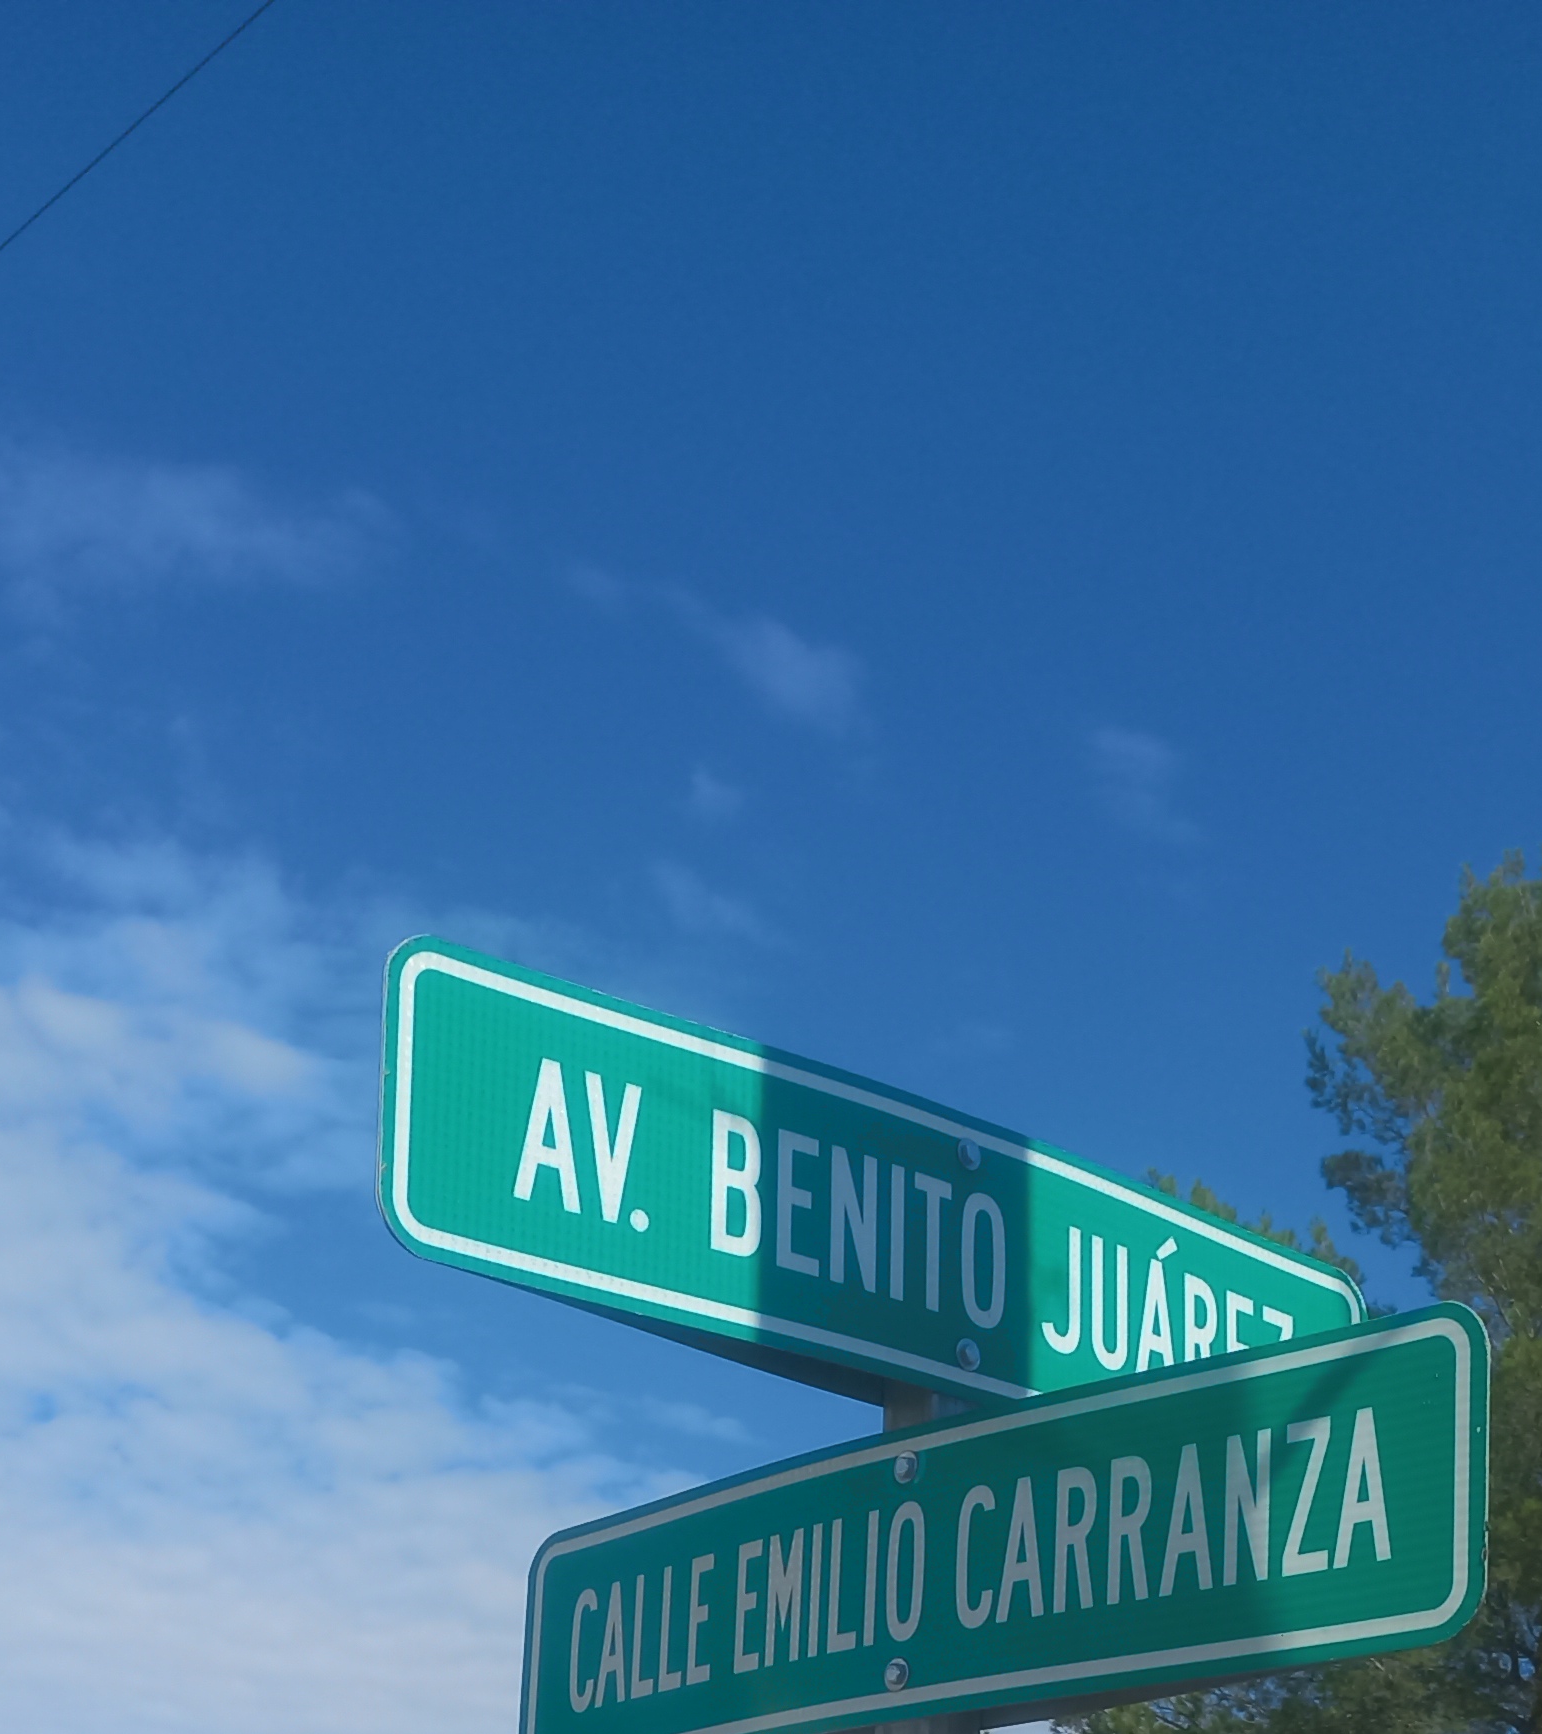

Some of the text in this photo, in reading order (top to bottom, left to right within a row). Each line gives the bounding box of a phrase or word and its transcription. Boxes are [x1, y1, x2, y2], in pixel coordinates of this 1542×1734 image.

[513, 1057, 649, 1232] AV.
[710, 1108, 1006, 1329] BENITO
[569, 1406, 1392, 1713] CALLE EMILIO CARRANZA
